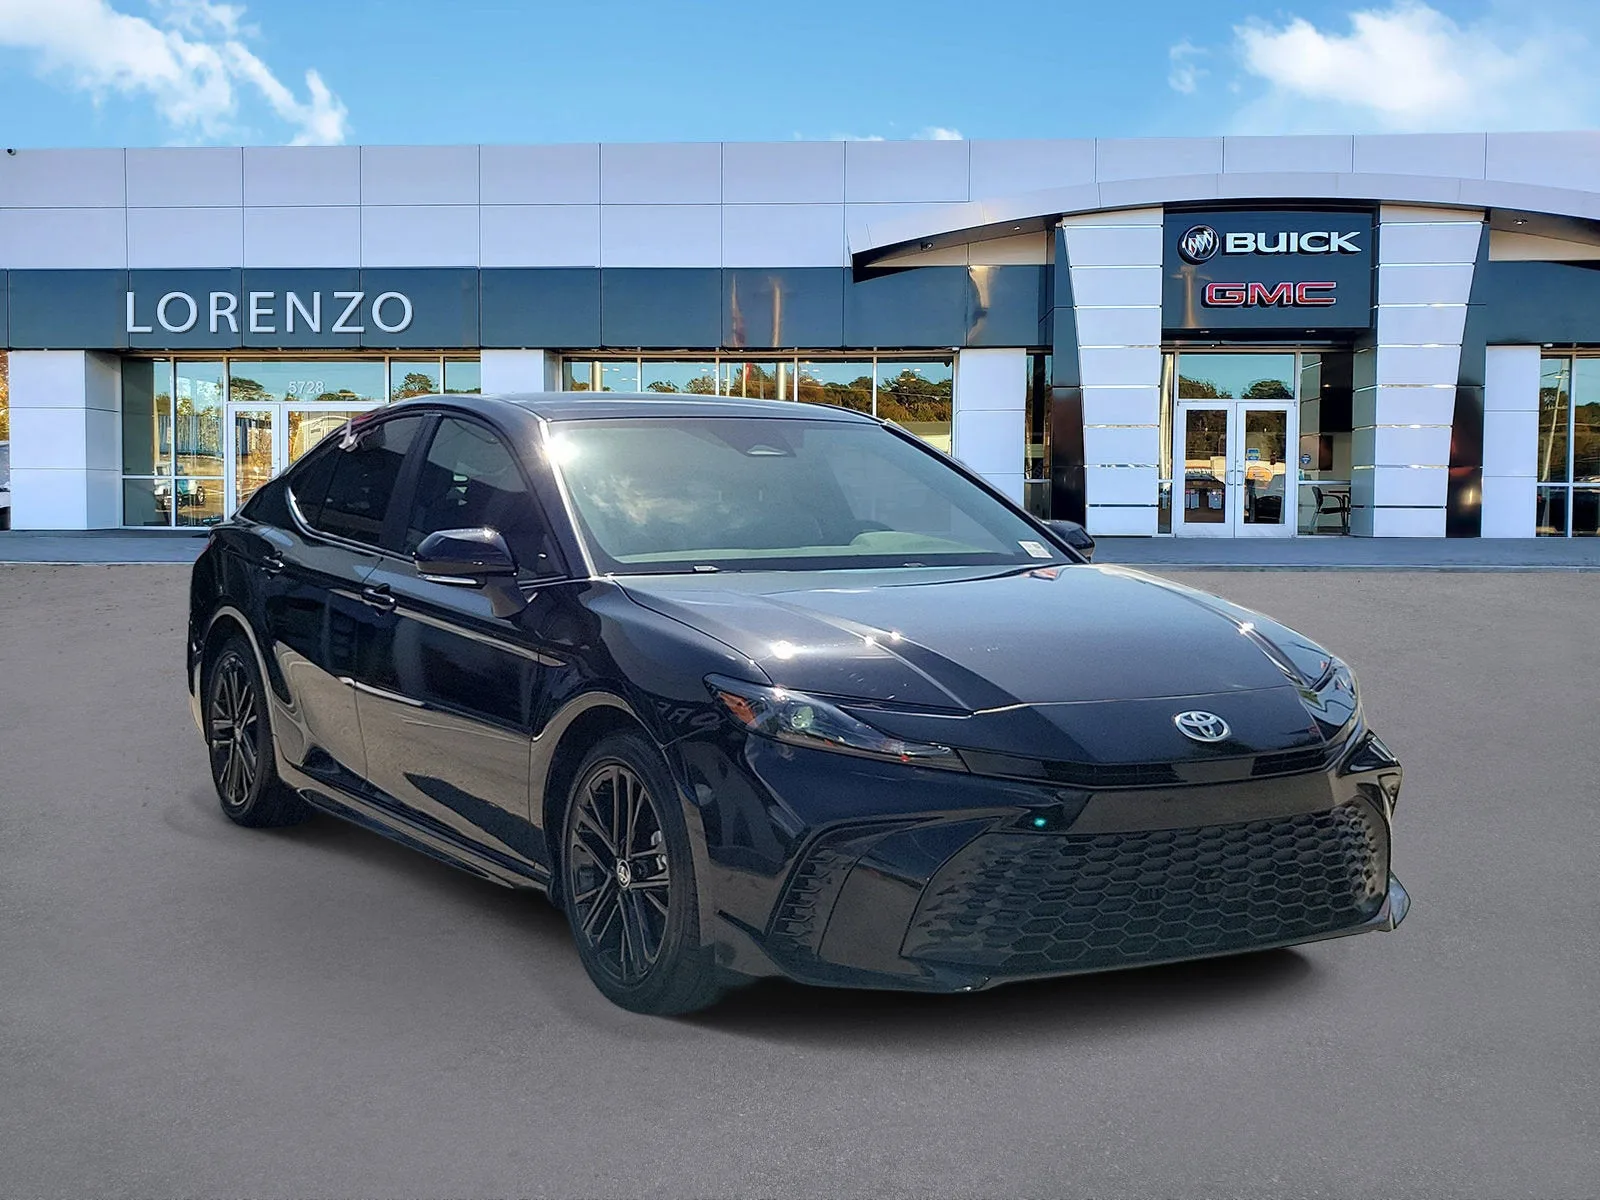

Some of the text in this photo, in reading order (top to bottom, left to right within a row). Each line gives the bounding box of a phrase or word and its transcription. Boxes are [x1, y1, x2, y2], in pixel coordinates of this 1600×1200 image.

[1226, 231, 1361, 253] BUICK
[1205, 282, 1337, 305] GMC
[126, 291, 413, 333] LORENZO
[288, 381, 325, 394] 5728
